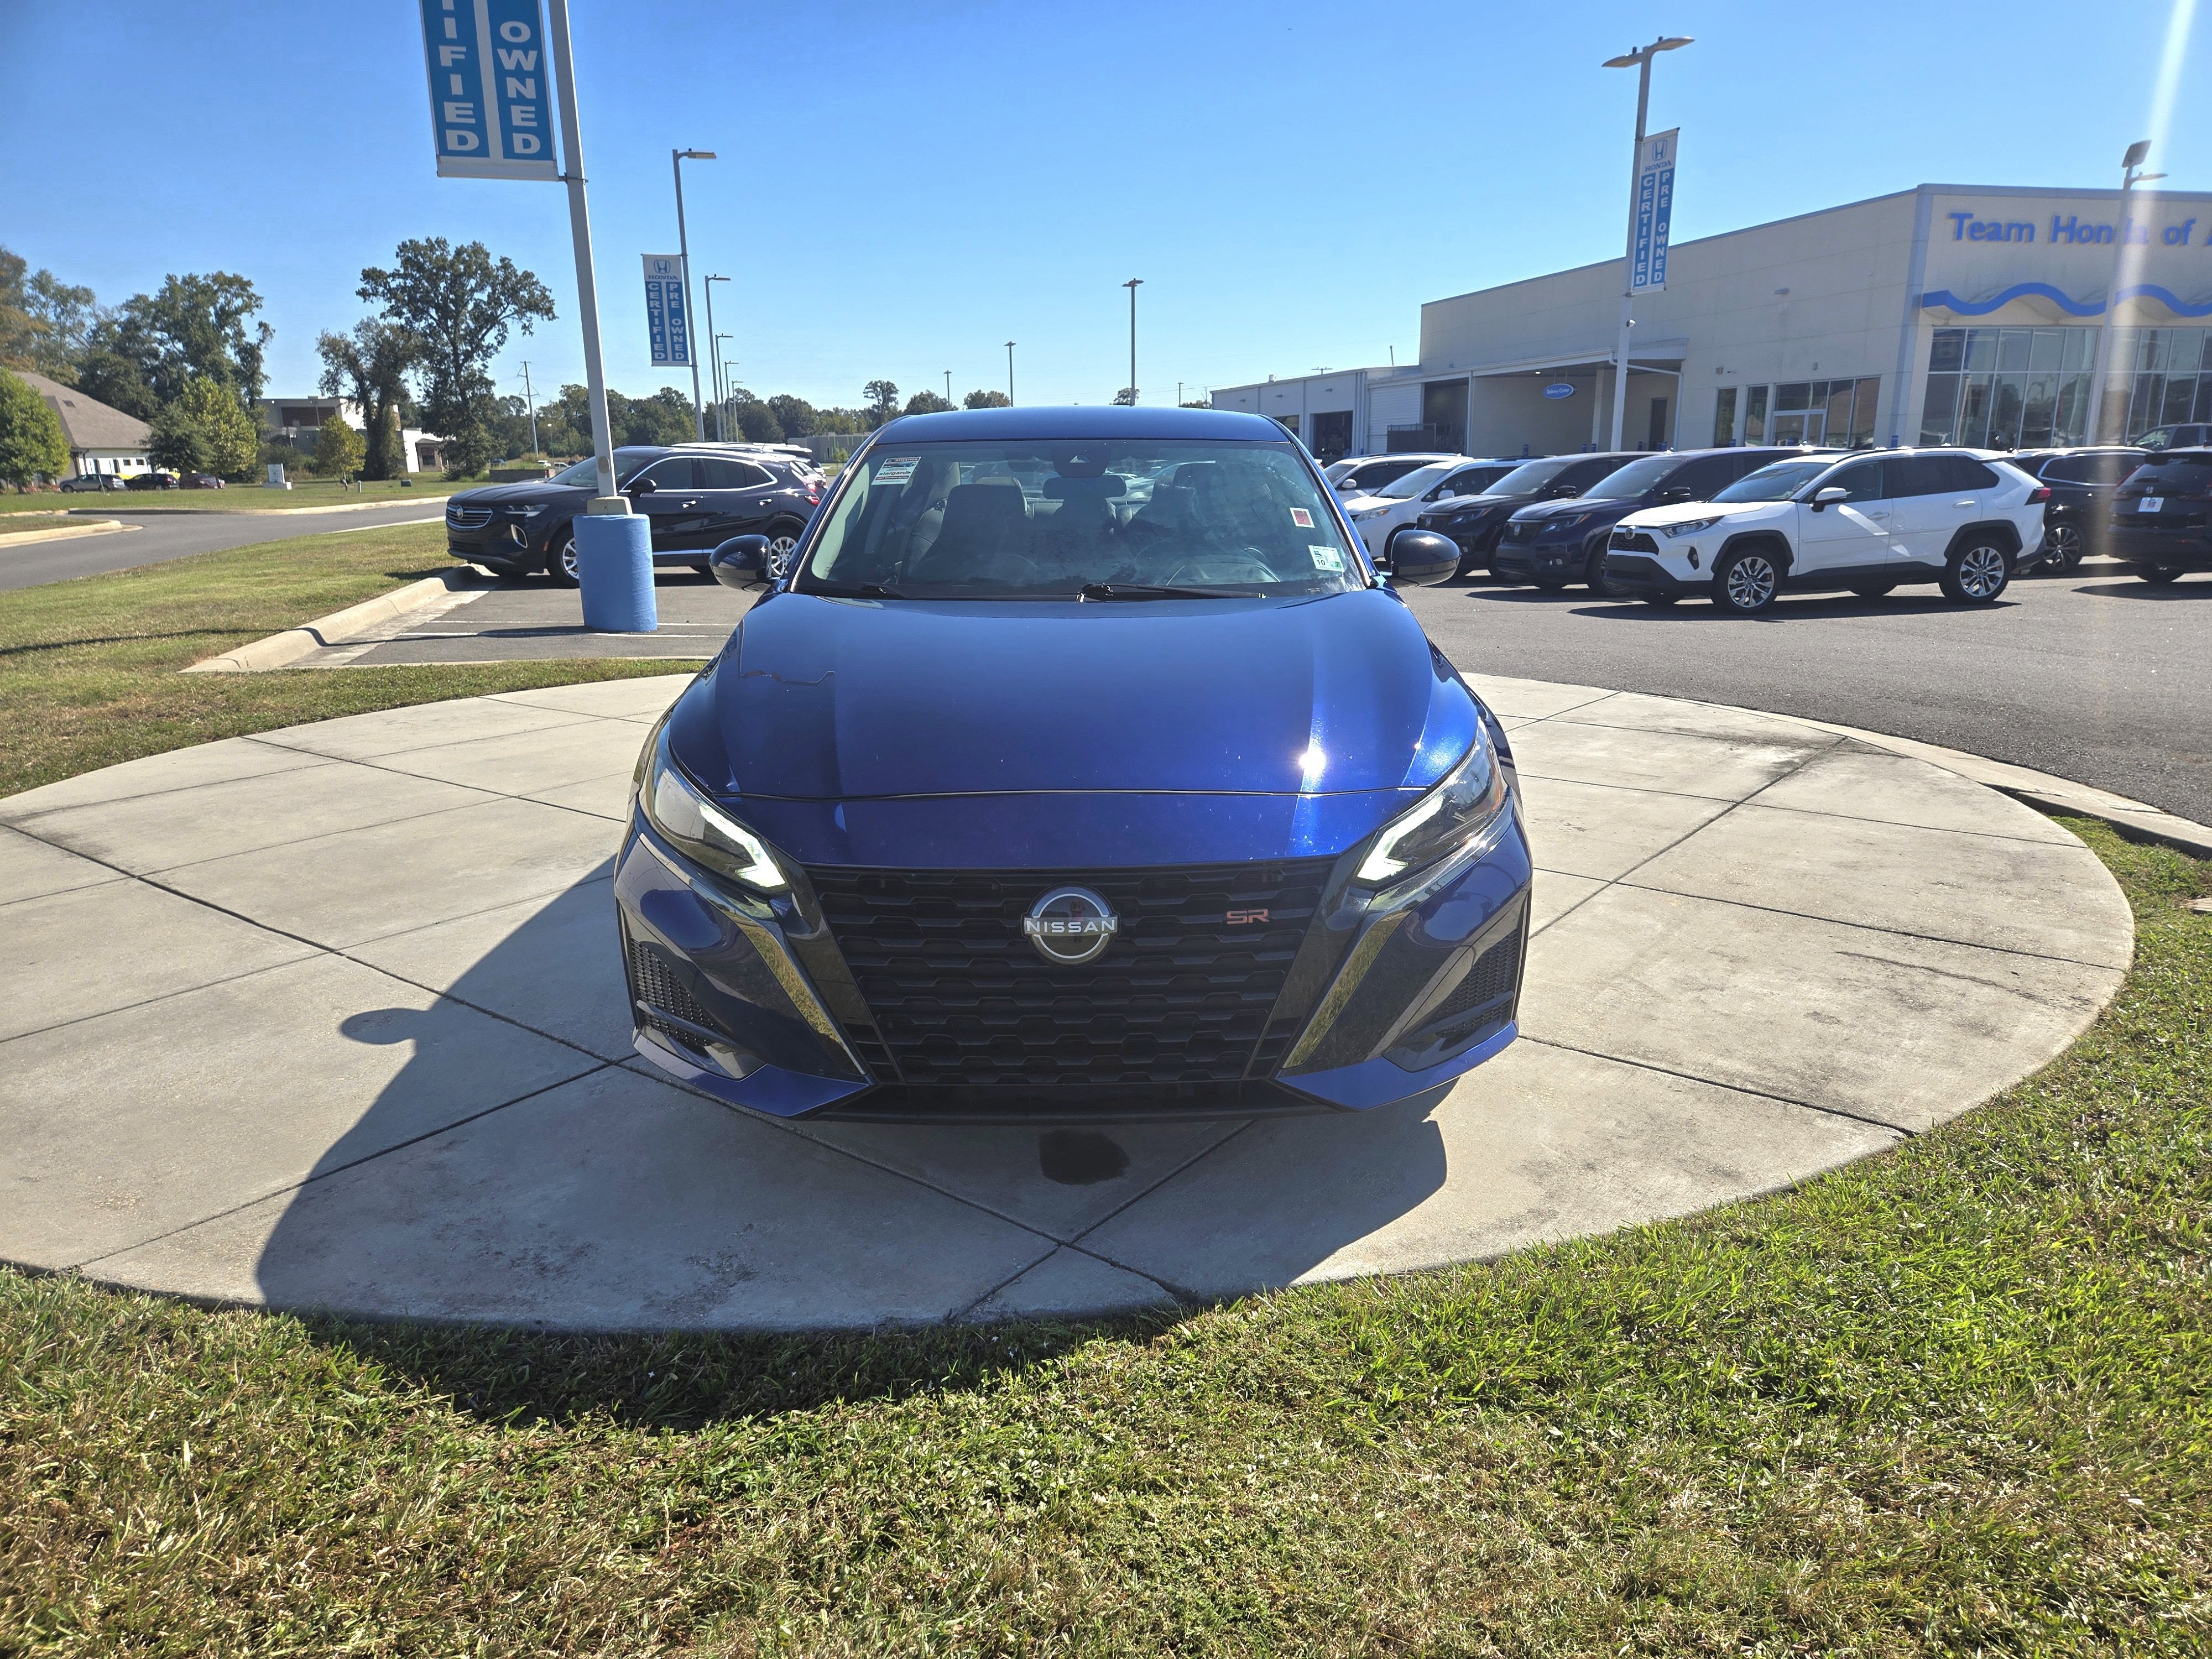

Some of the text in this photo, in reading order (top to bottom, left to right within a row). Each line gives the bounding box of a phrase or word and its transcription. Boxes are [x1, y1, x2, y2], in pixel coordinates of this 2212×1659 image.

[439, 0, 479, 152] IFIED
[497, 21, 541, 154] OWNED
[1645, 160, 1672, 172] HONDA
[1635, 175, 1653, 285] CERTIFIED
[1654, 172, 1671, 281] PRE OWNED
[1949, 212, 2036, 243] Team
[2163, 218, 2197, 246] of
[648, 283, 665, 359] CERTIFIED
[670, 284, 685, 359] PRE OWNED
[1026, 919, 1116, 933] NISSAN
[1226, 908, 1270, 925] SR
